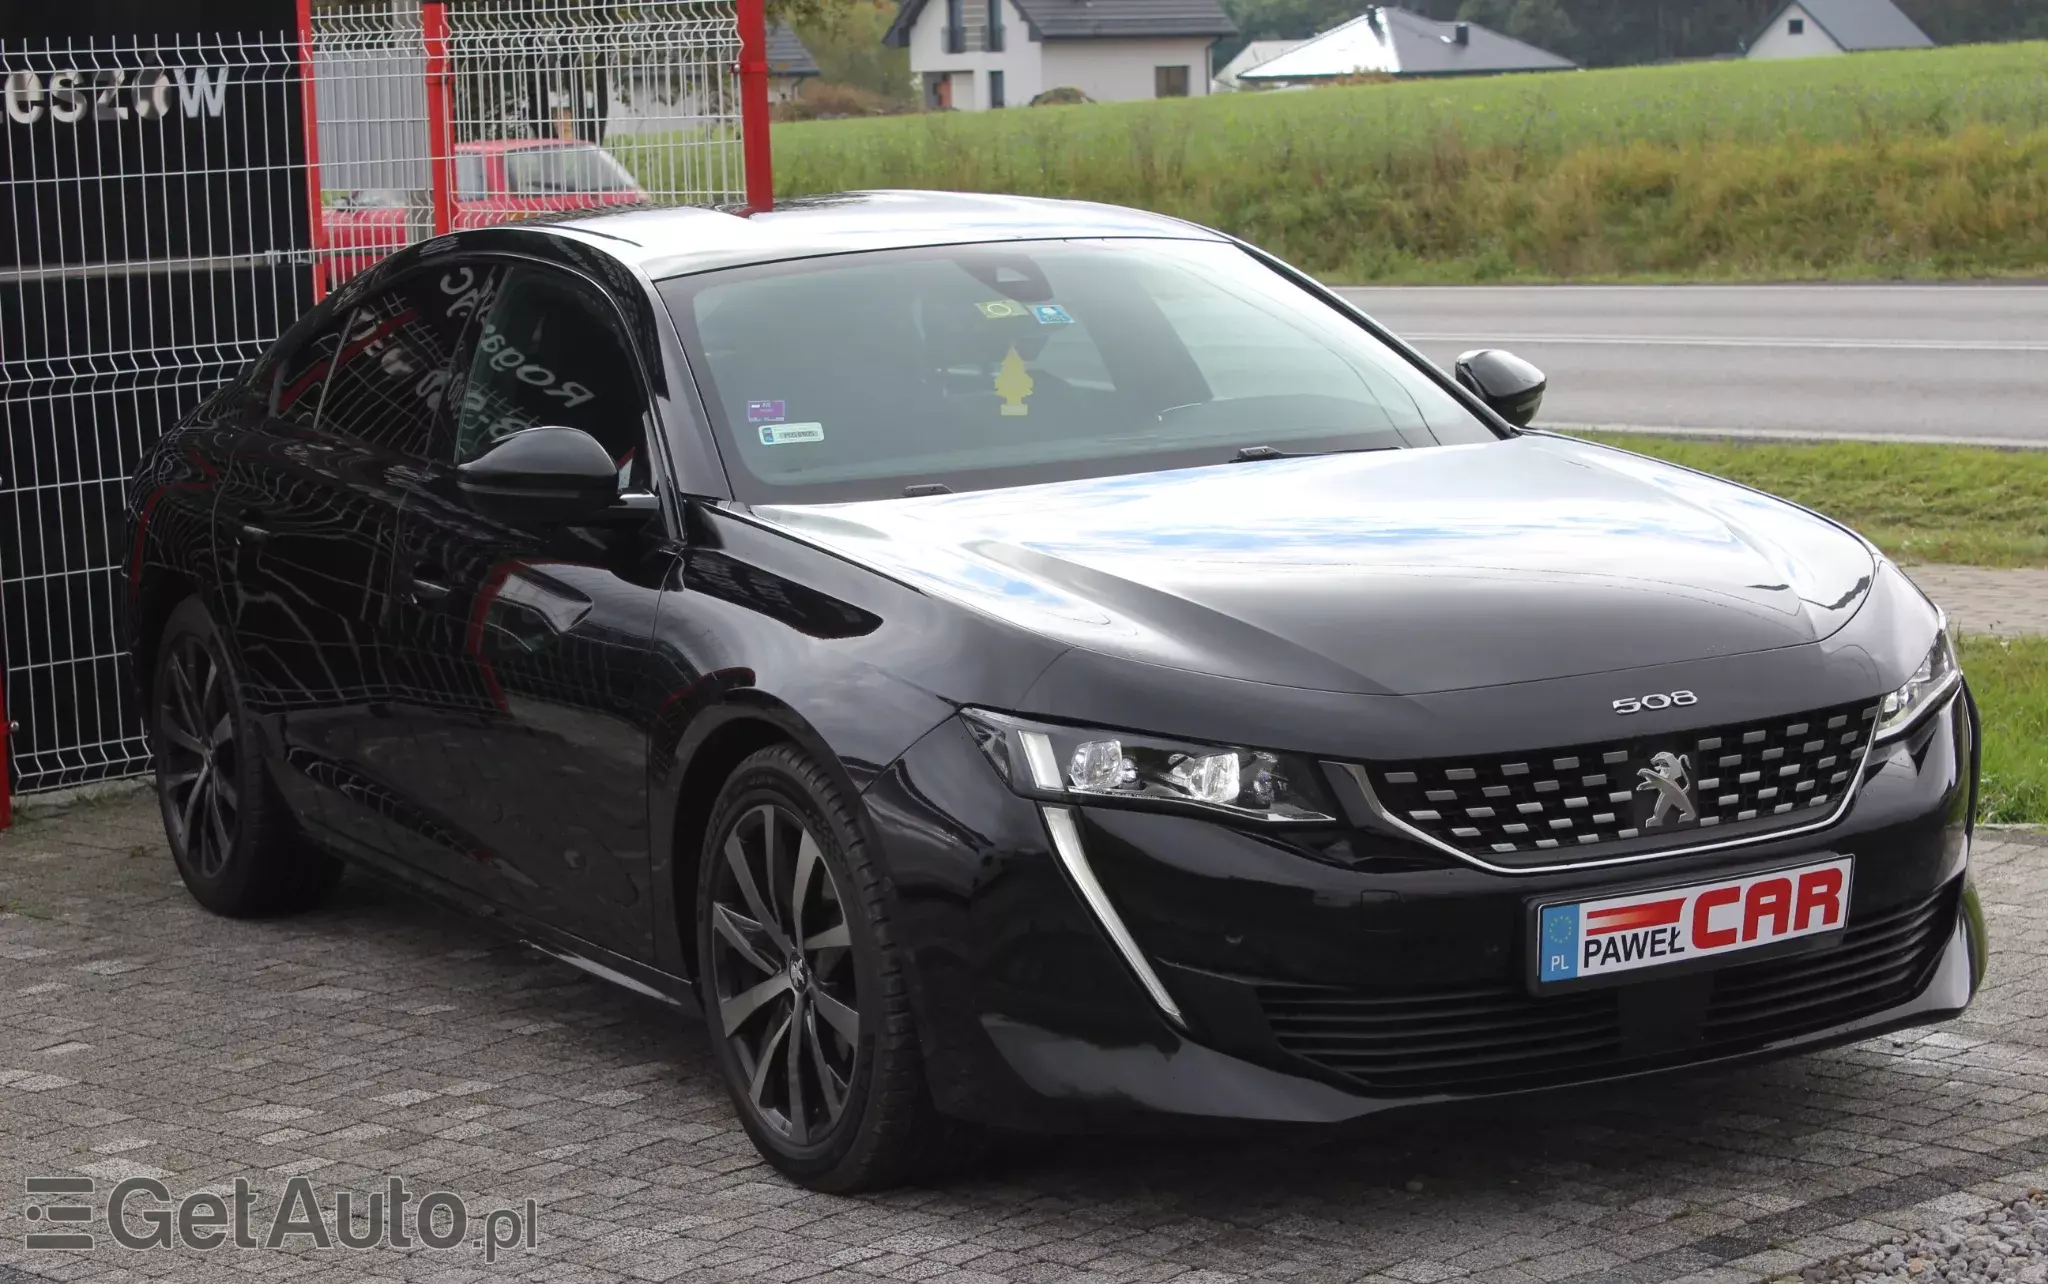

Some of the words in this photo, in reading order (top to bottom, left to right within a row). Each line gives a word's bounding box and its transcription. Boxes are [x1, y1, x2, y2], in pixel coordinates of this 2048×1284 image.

[1612, 690, 1698, 715] 508
[1583, 926, 1686, 969] PAWEŁ
[1691, 867, 1843, 950] CAR
[1550, 954, 1569, 972] PL
